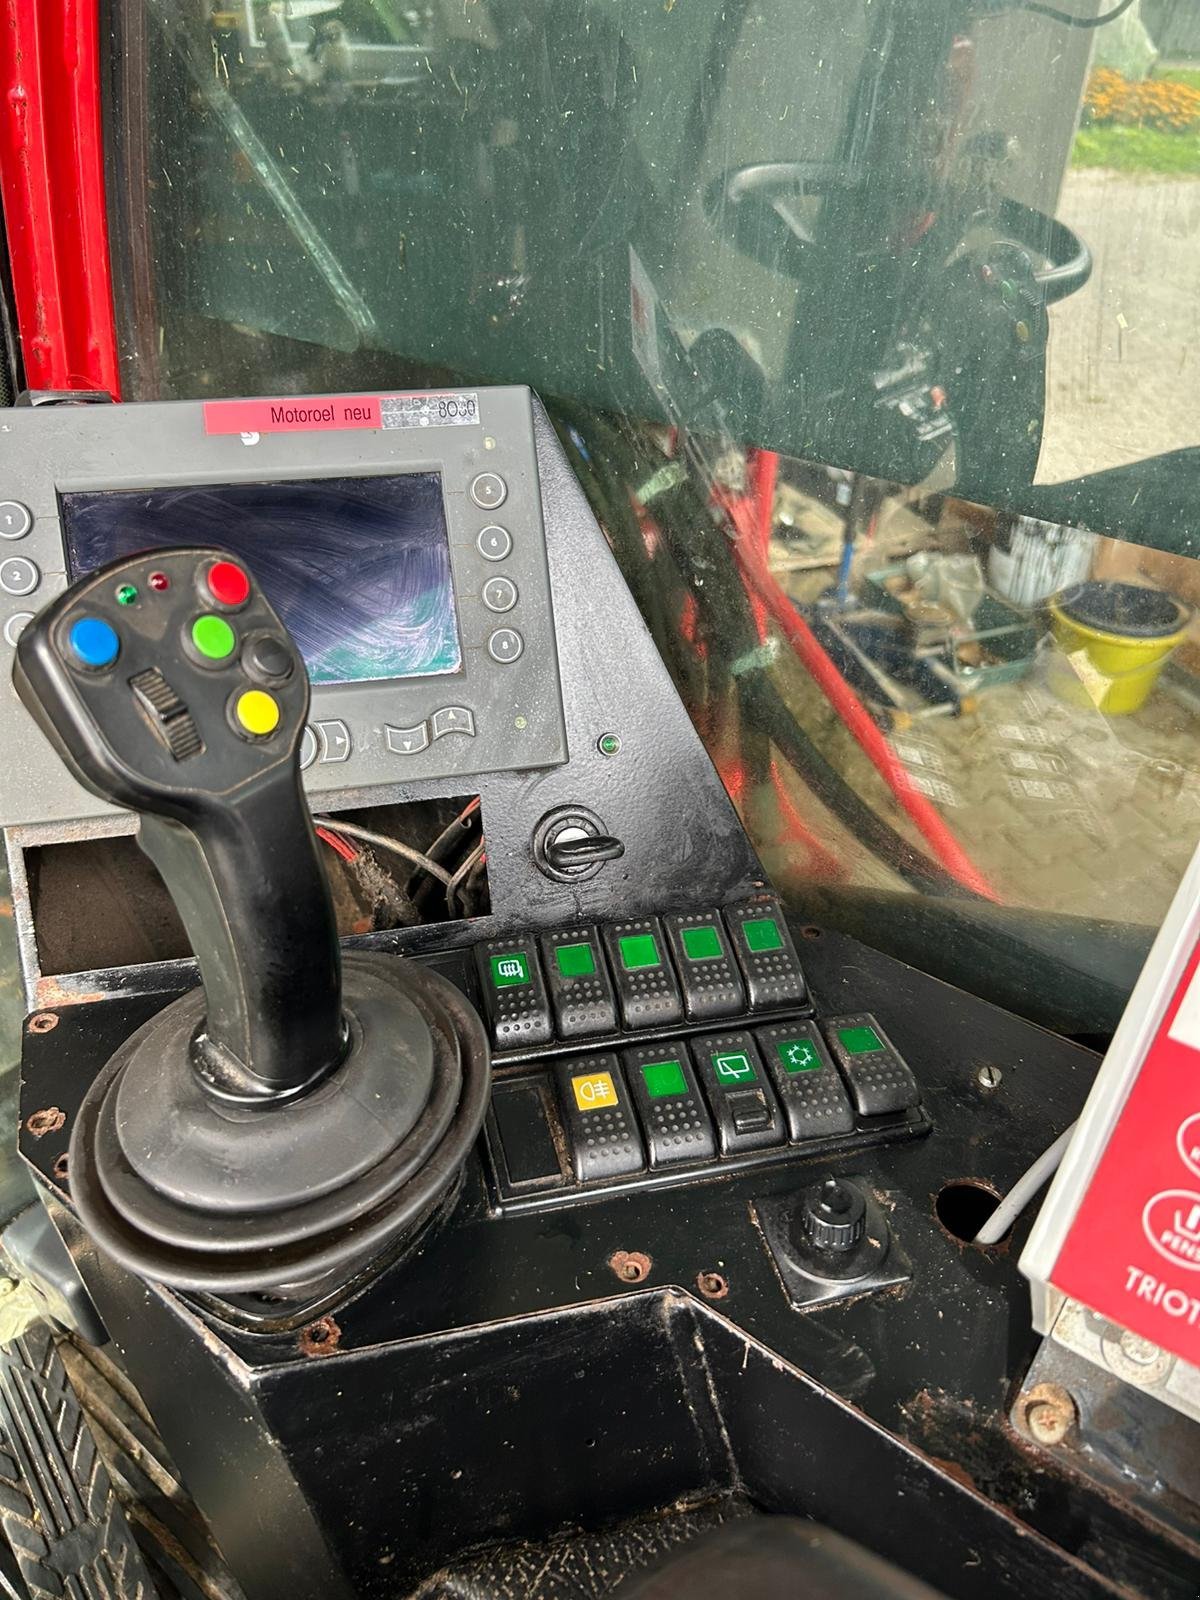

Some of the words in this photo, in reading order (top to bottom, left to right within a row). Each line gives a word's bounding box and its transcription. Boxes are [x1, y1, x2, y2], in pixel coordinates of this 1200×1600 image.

[270, 405, 335, 424] Motoroel
[344, 407, 371, 421] neu
[485, 487, 492, 495] 5
[490, 538, 497, 547] 6
[12, 571, 21, 581] 2
[496, 590, 502, 598] 7
[501, 641, 508, 650] 8
